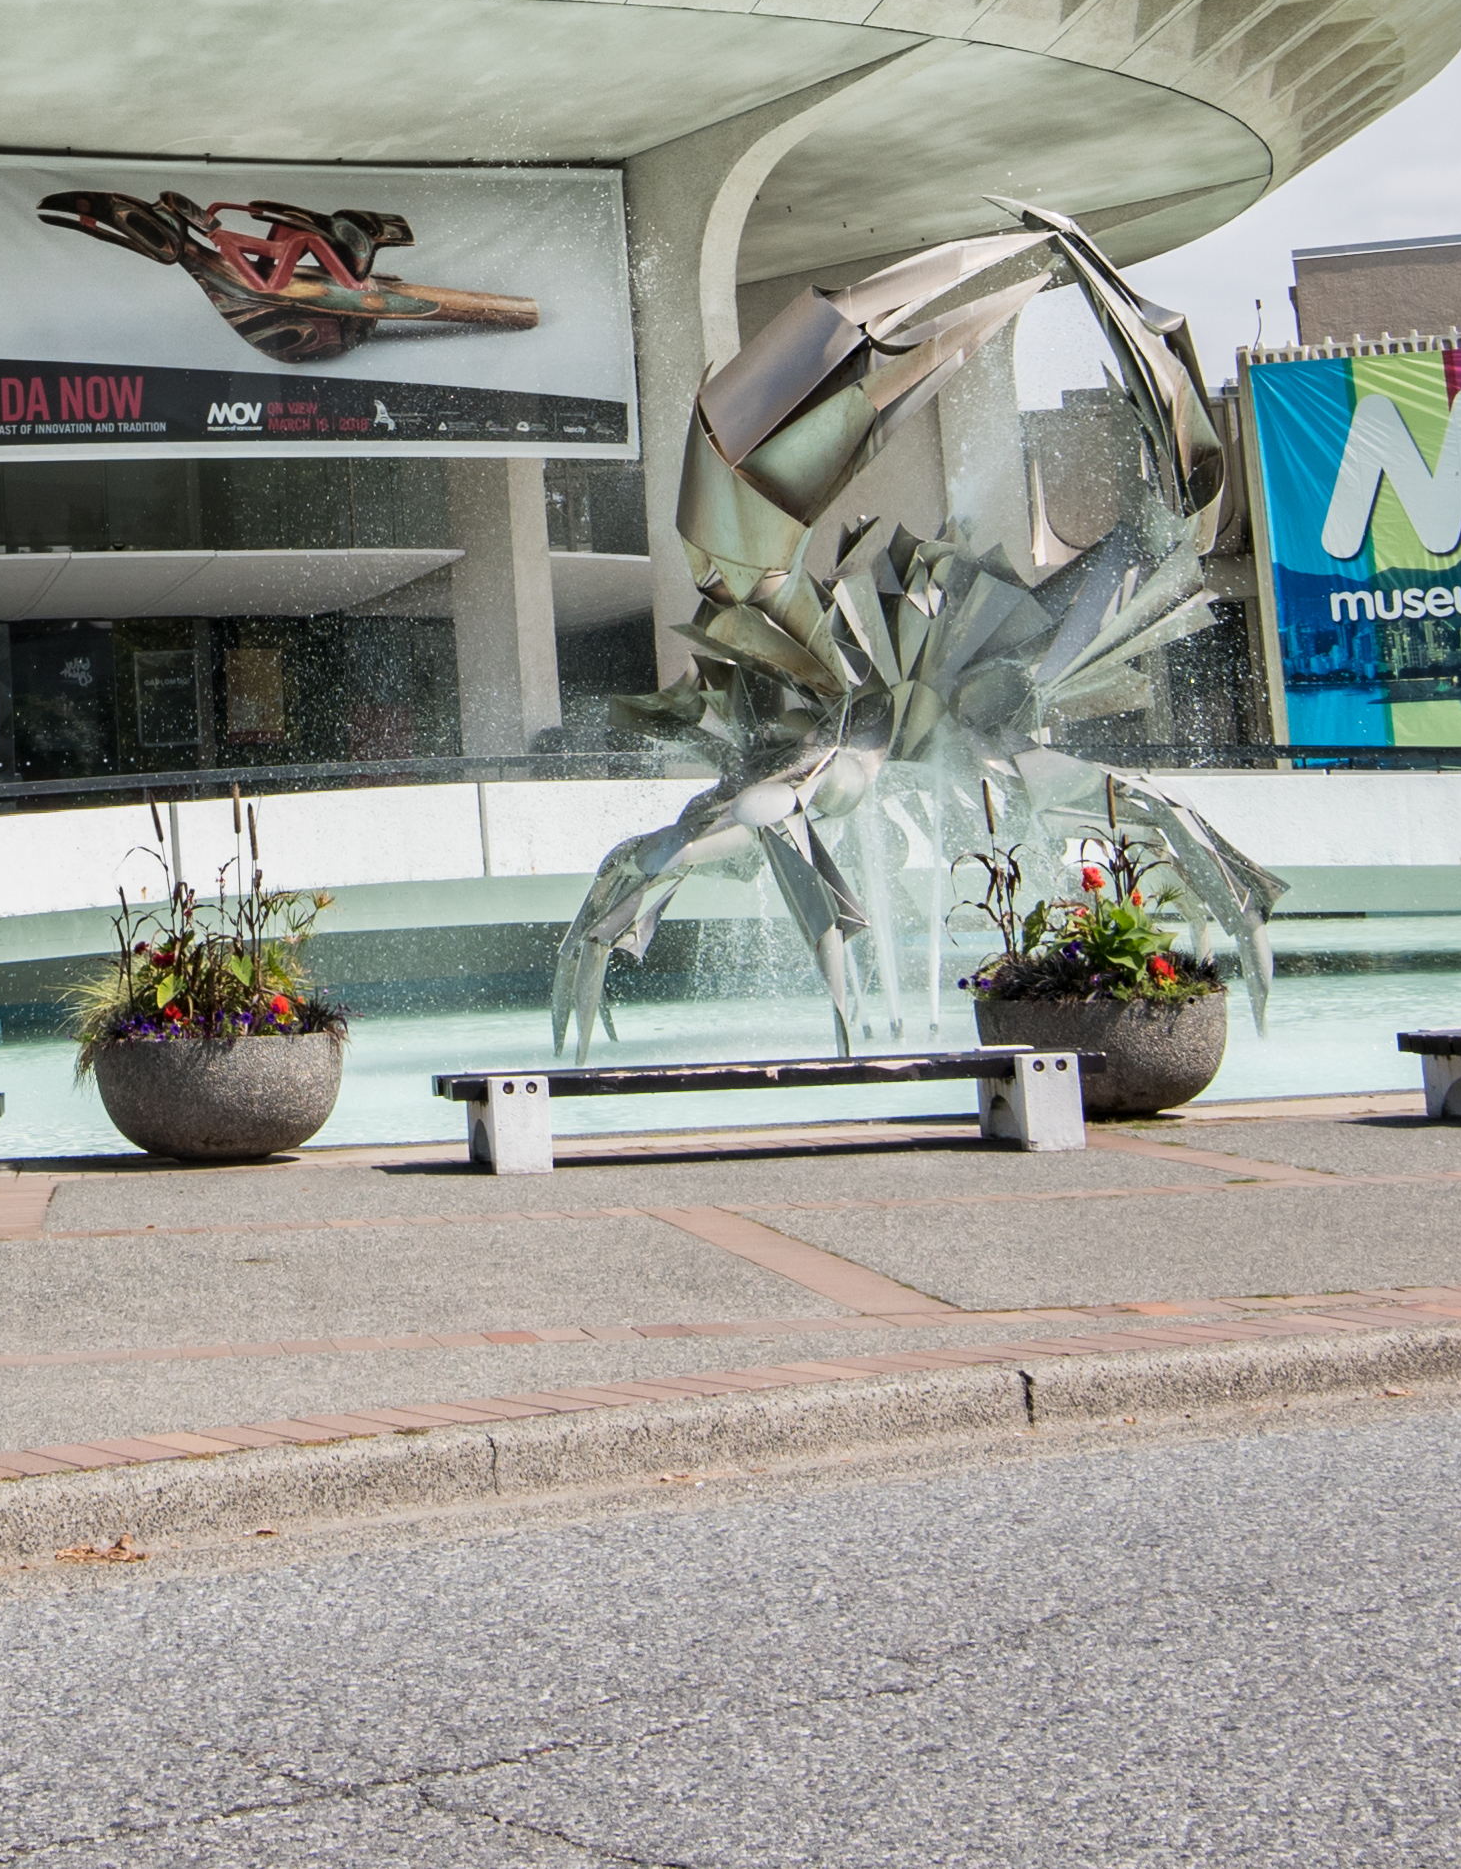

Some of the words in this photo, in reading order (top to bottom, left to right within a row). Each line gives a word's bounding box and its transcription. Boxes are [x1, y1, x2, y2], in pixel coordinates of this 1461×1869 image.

[59, 375, 144, 421] NOW
[207, 402, 262, 425] MOV
[267, 402, 283, 415] ON
[287, 402, 318, 415] VIEW
[20, 424, 32, 434] OF
[35, 423, 92, 434] INNOVATION
[95, 422, 115, 433] AND
[118, 421, 167, 433] TRADITION
[267, 417, 311, 431] MARCH
[339, 417, 369, 431] 2018
